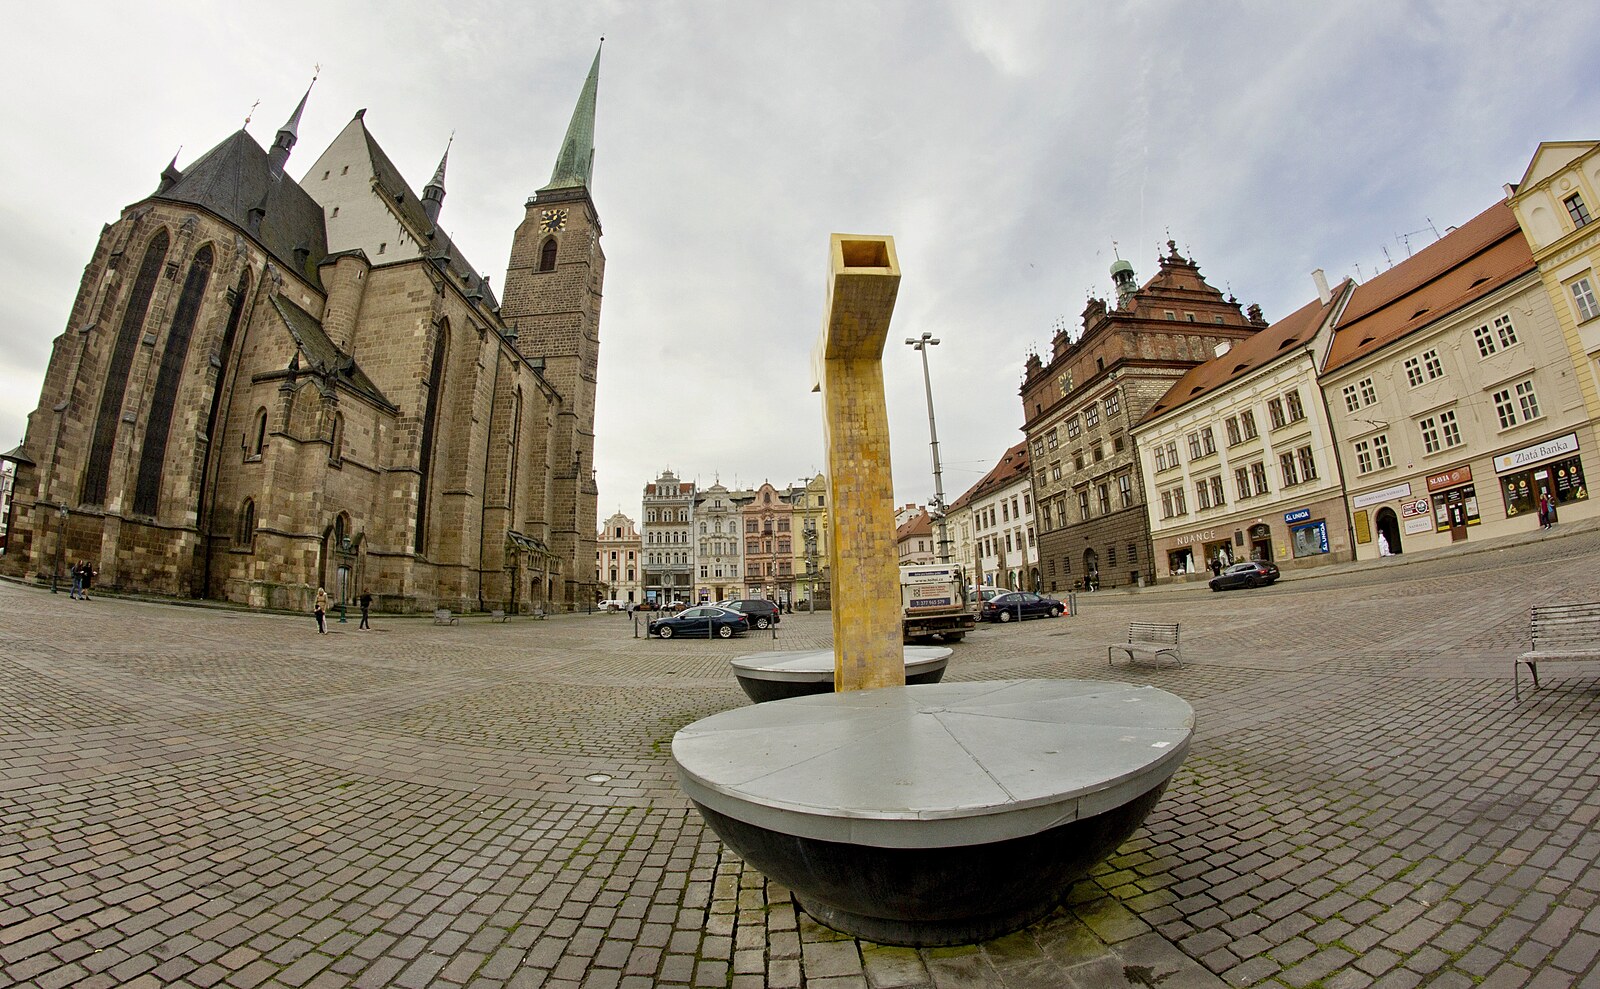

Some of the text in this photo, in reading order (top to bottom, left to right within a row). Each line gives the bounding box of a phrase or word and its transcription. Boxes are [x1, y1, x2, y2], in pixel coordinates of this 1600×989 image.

[1514, 442, 1568, 464] Zlatá Banka
[1429, 474, 1450, 485] SLAVIA
[1292, 511, 1309, 520] UNIQA
[1177, 530, 1216, 546] NUANCE
